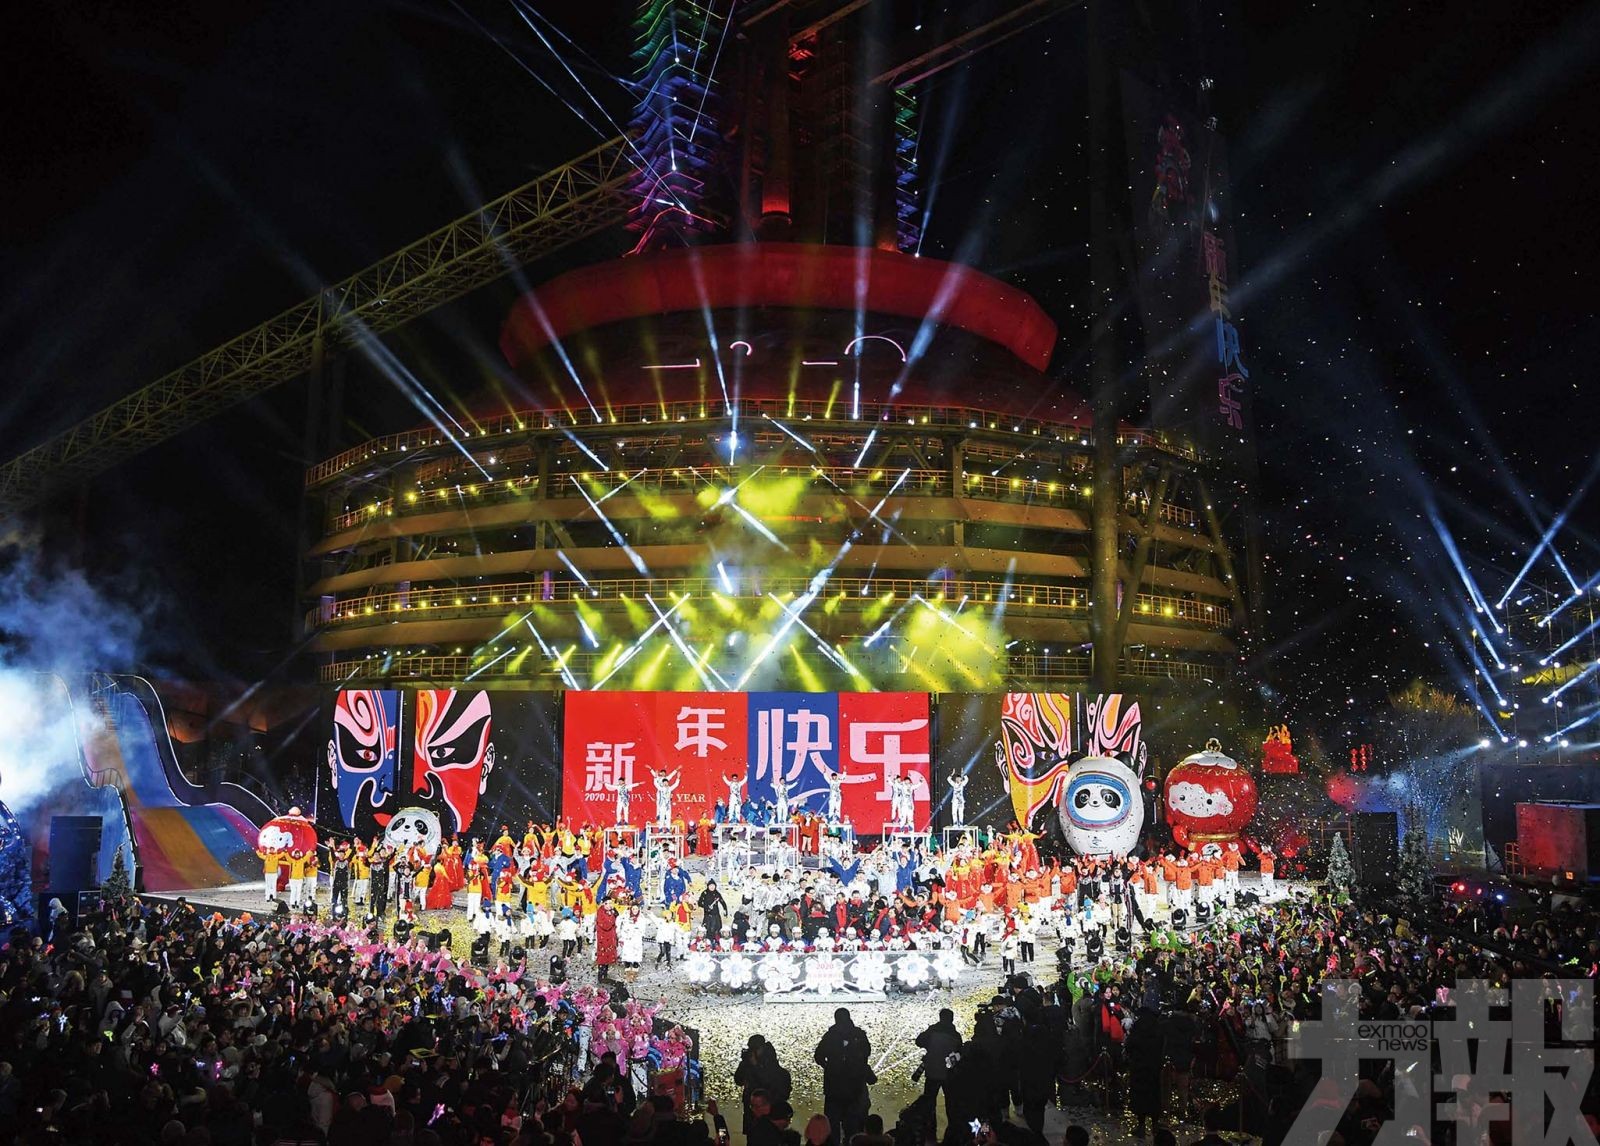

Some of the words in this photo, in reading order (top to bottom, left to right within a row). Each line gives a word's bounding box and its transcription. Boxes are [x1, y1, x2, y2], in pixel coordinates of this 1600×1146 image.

[585, 706, 930, 801] 新年快乐
[585, 793, 605, 802] 2020
[676, 793, 706, 803] YEAR
